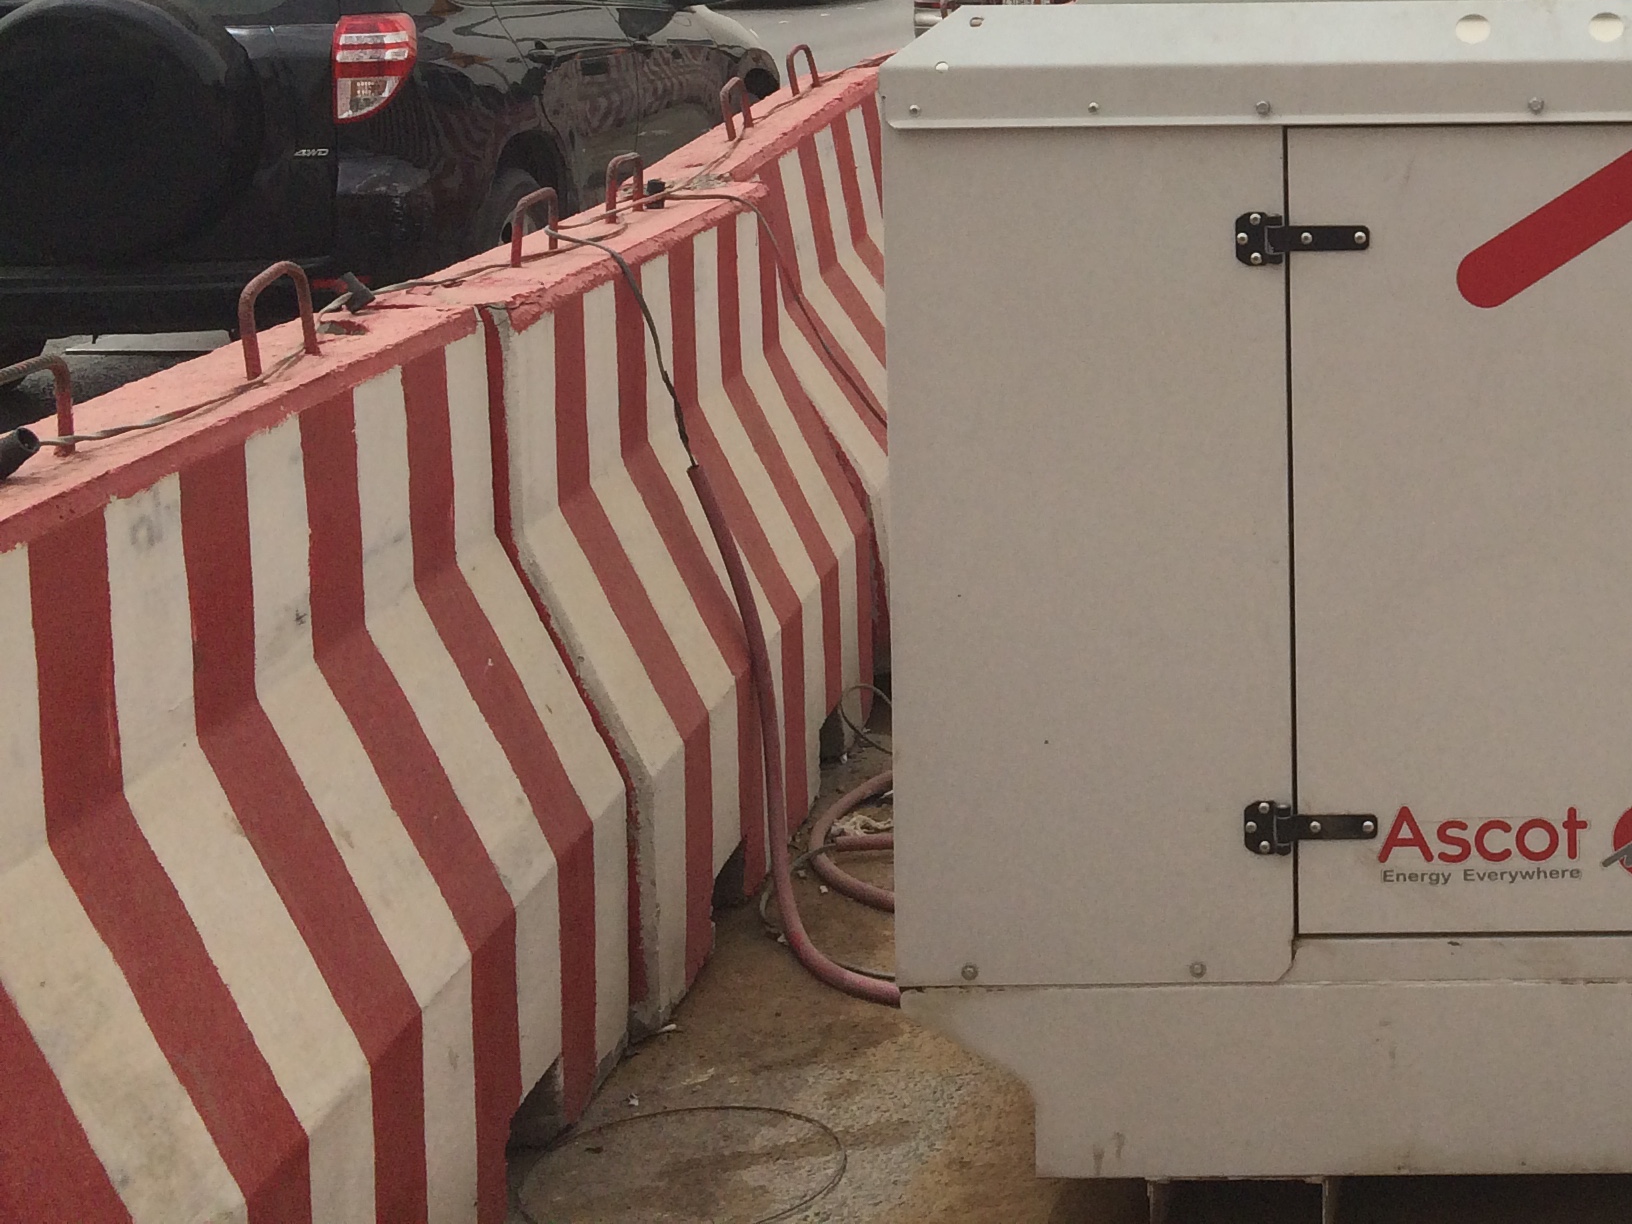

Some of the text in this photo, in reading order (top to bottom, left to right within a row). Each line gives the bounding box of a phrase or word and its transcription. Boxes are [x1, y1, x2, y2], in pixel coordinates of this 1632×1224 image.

[294, 148, 330, 157] 4WD
[1377, 805, 1589, 864] Ascot
[1382, 867, 1581, 886] Energy Everywhere
